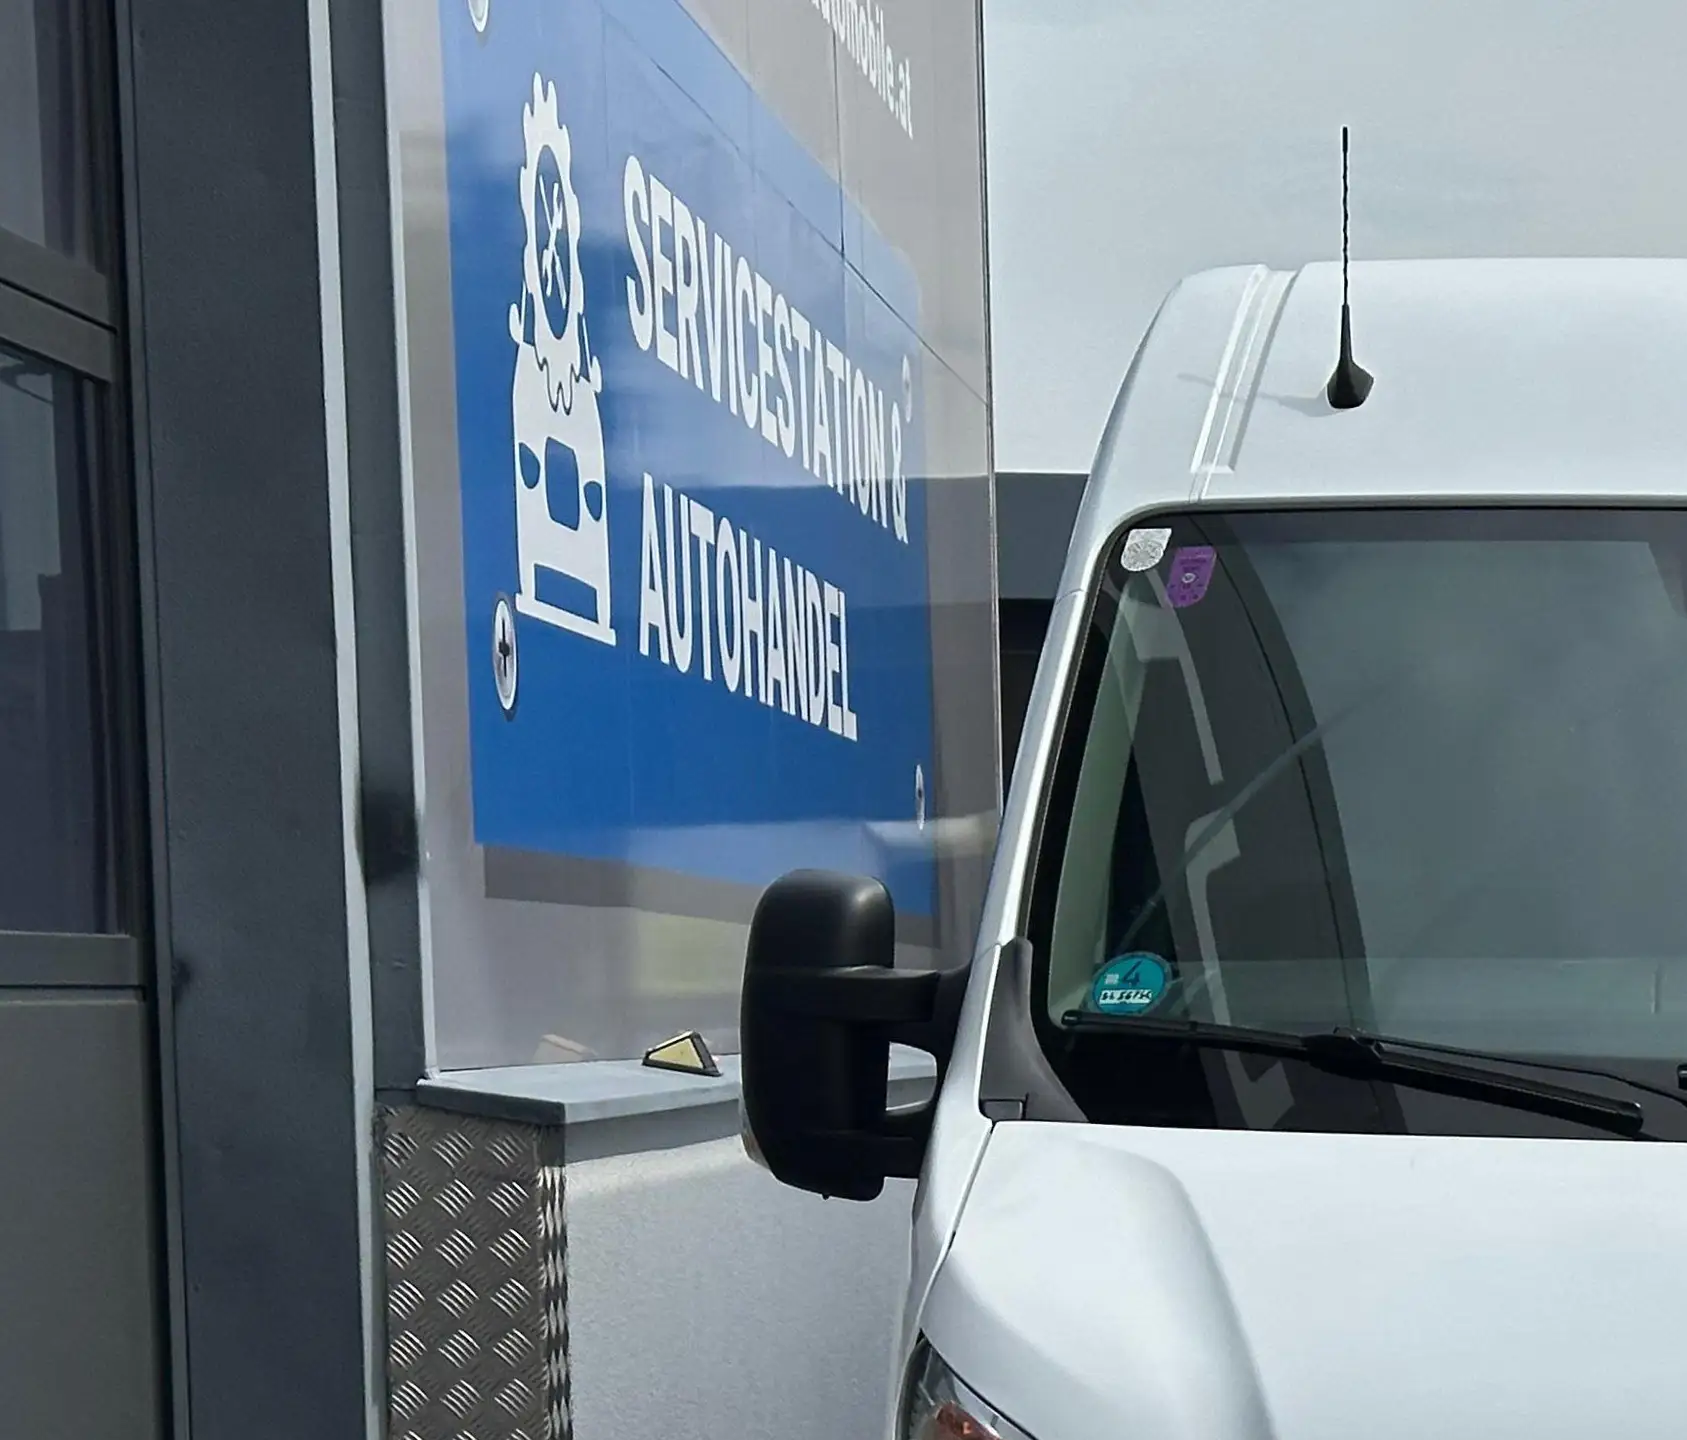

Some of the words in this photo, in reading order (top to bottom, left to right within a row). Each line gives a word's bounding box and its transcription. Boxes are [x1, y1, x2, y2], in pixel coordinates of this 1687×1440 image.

[624, 155, 888, 529] SERVICESTATION
[891, 400, 909, 544] &
[639, 472, 858, 742] AUTOHANDEL
